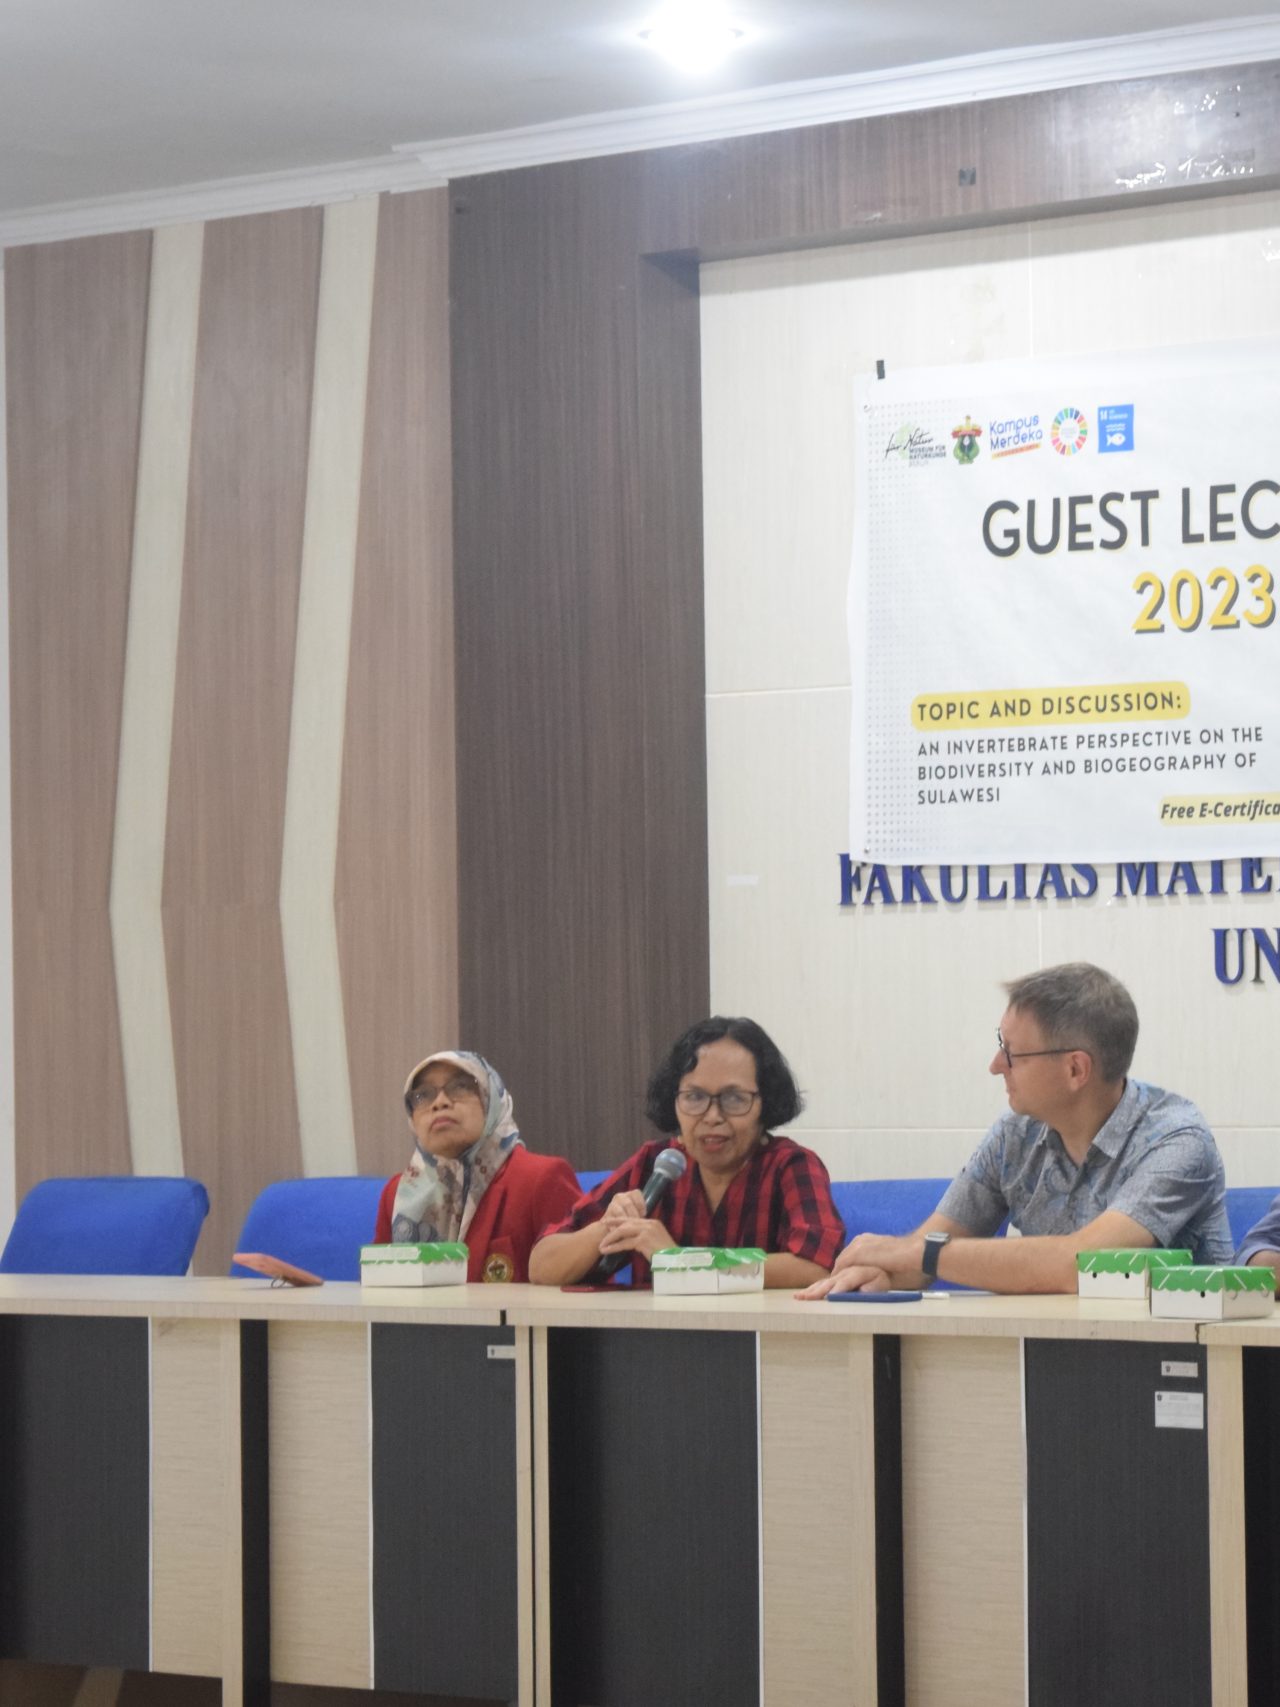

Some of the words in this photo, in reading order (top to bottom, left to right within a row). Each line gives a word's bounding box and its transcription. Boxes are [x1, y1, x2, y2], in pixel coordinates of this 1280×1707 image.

[989, 415, 1040, 435] Kampus
[990, 428, 1043, 451] Merdeka
[982, 489, 1160, 558] GUEST
[1132, 563, 1277, 634] 2023
[917, 701, 980, 721] TOPIC
[989, 698, 1032, 719] AND
[1041, 691, 1182, 716] DISCUSSION:
[918, 741, 940, 756] AN
[947, 735, 1069, 755] INVERTEBRATE
[1076, 729, 1192, 750] PERSPECTIVE
[1199, 728, 1225, 744] ON
[1232, 726, 1264, 743] THE
[918, 761, 1034, 781] BIODIVERSITY
[1041, 759, 1076, 776] AND
[1084, 753, 1227, 774] BIOGEOGRAPHY
[1234, 752, 1258, 768] OF
[917, 787, 1001, 805] SULAWESI
[1160, 803, 1195, 820] Free
